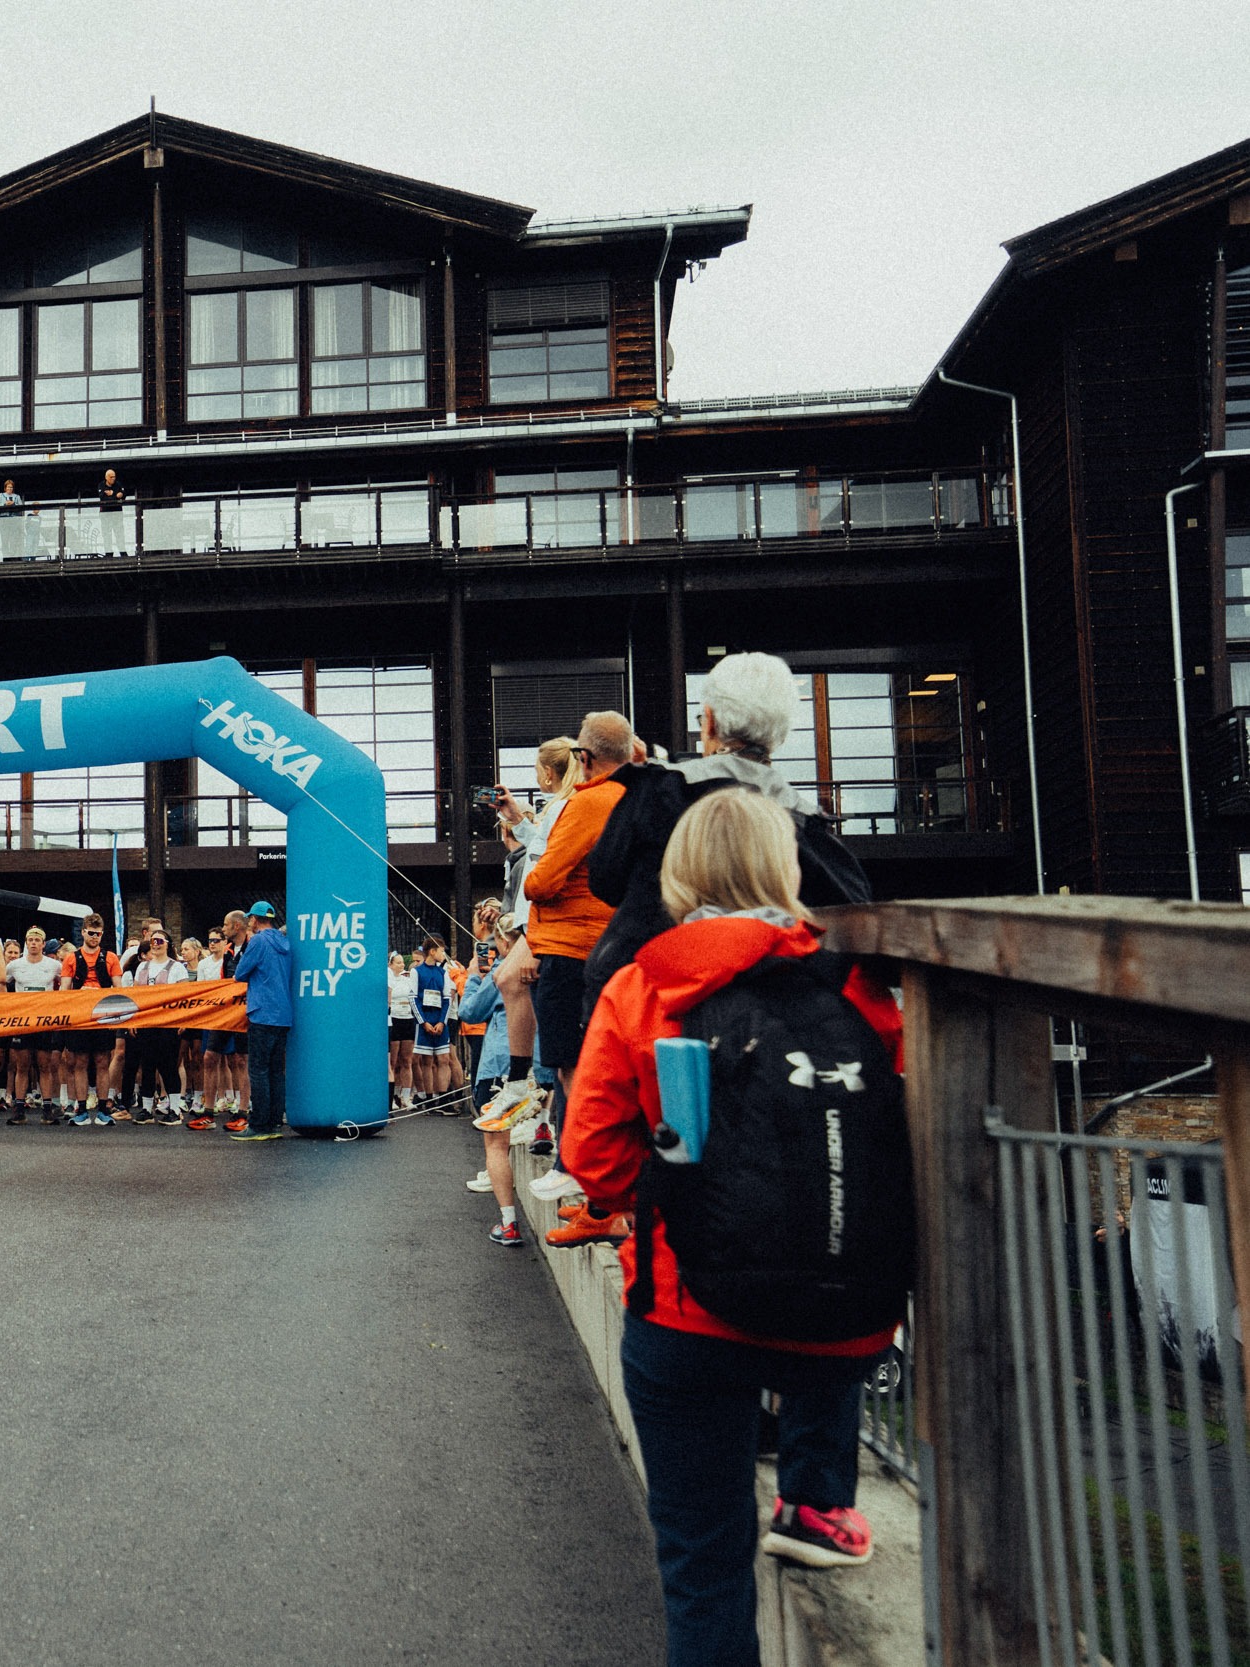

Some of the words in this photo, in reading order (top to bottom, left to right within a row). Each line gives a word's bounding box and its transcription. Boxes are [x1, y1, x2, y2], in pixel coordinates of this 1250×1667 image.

[200, 700, 323, 789] HOKA
[258, 852, 287, 860] Parkerin
[297, 912, 366, 941] TIME
[325, 941, 368, 969] TO
[36, 1015, 72, 1027] TRAIL
[826, 1109, 844, 1173] UNDER
[829, 1173, 845, 1255] ARMOUR
